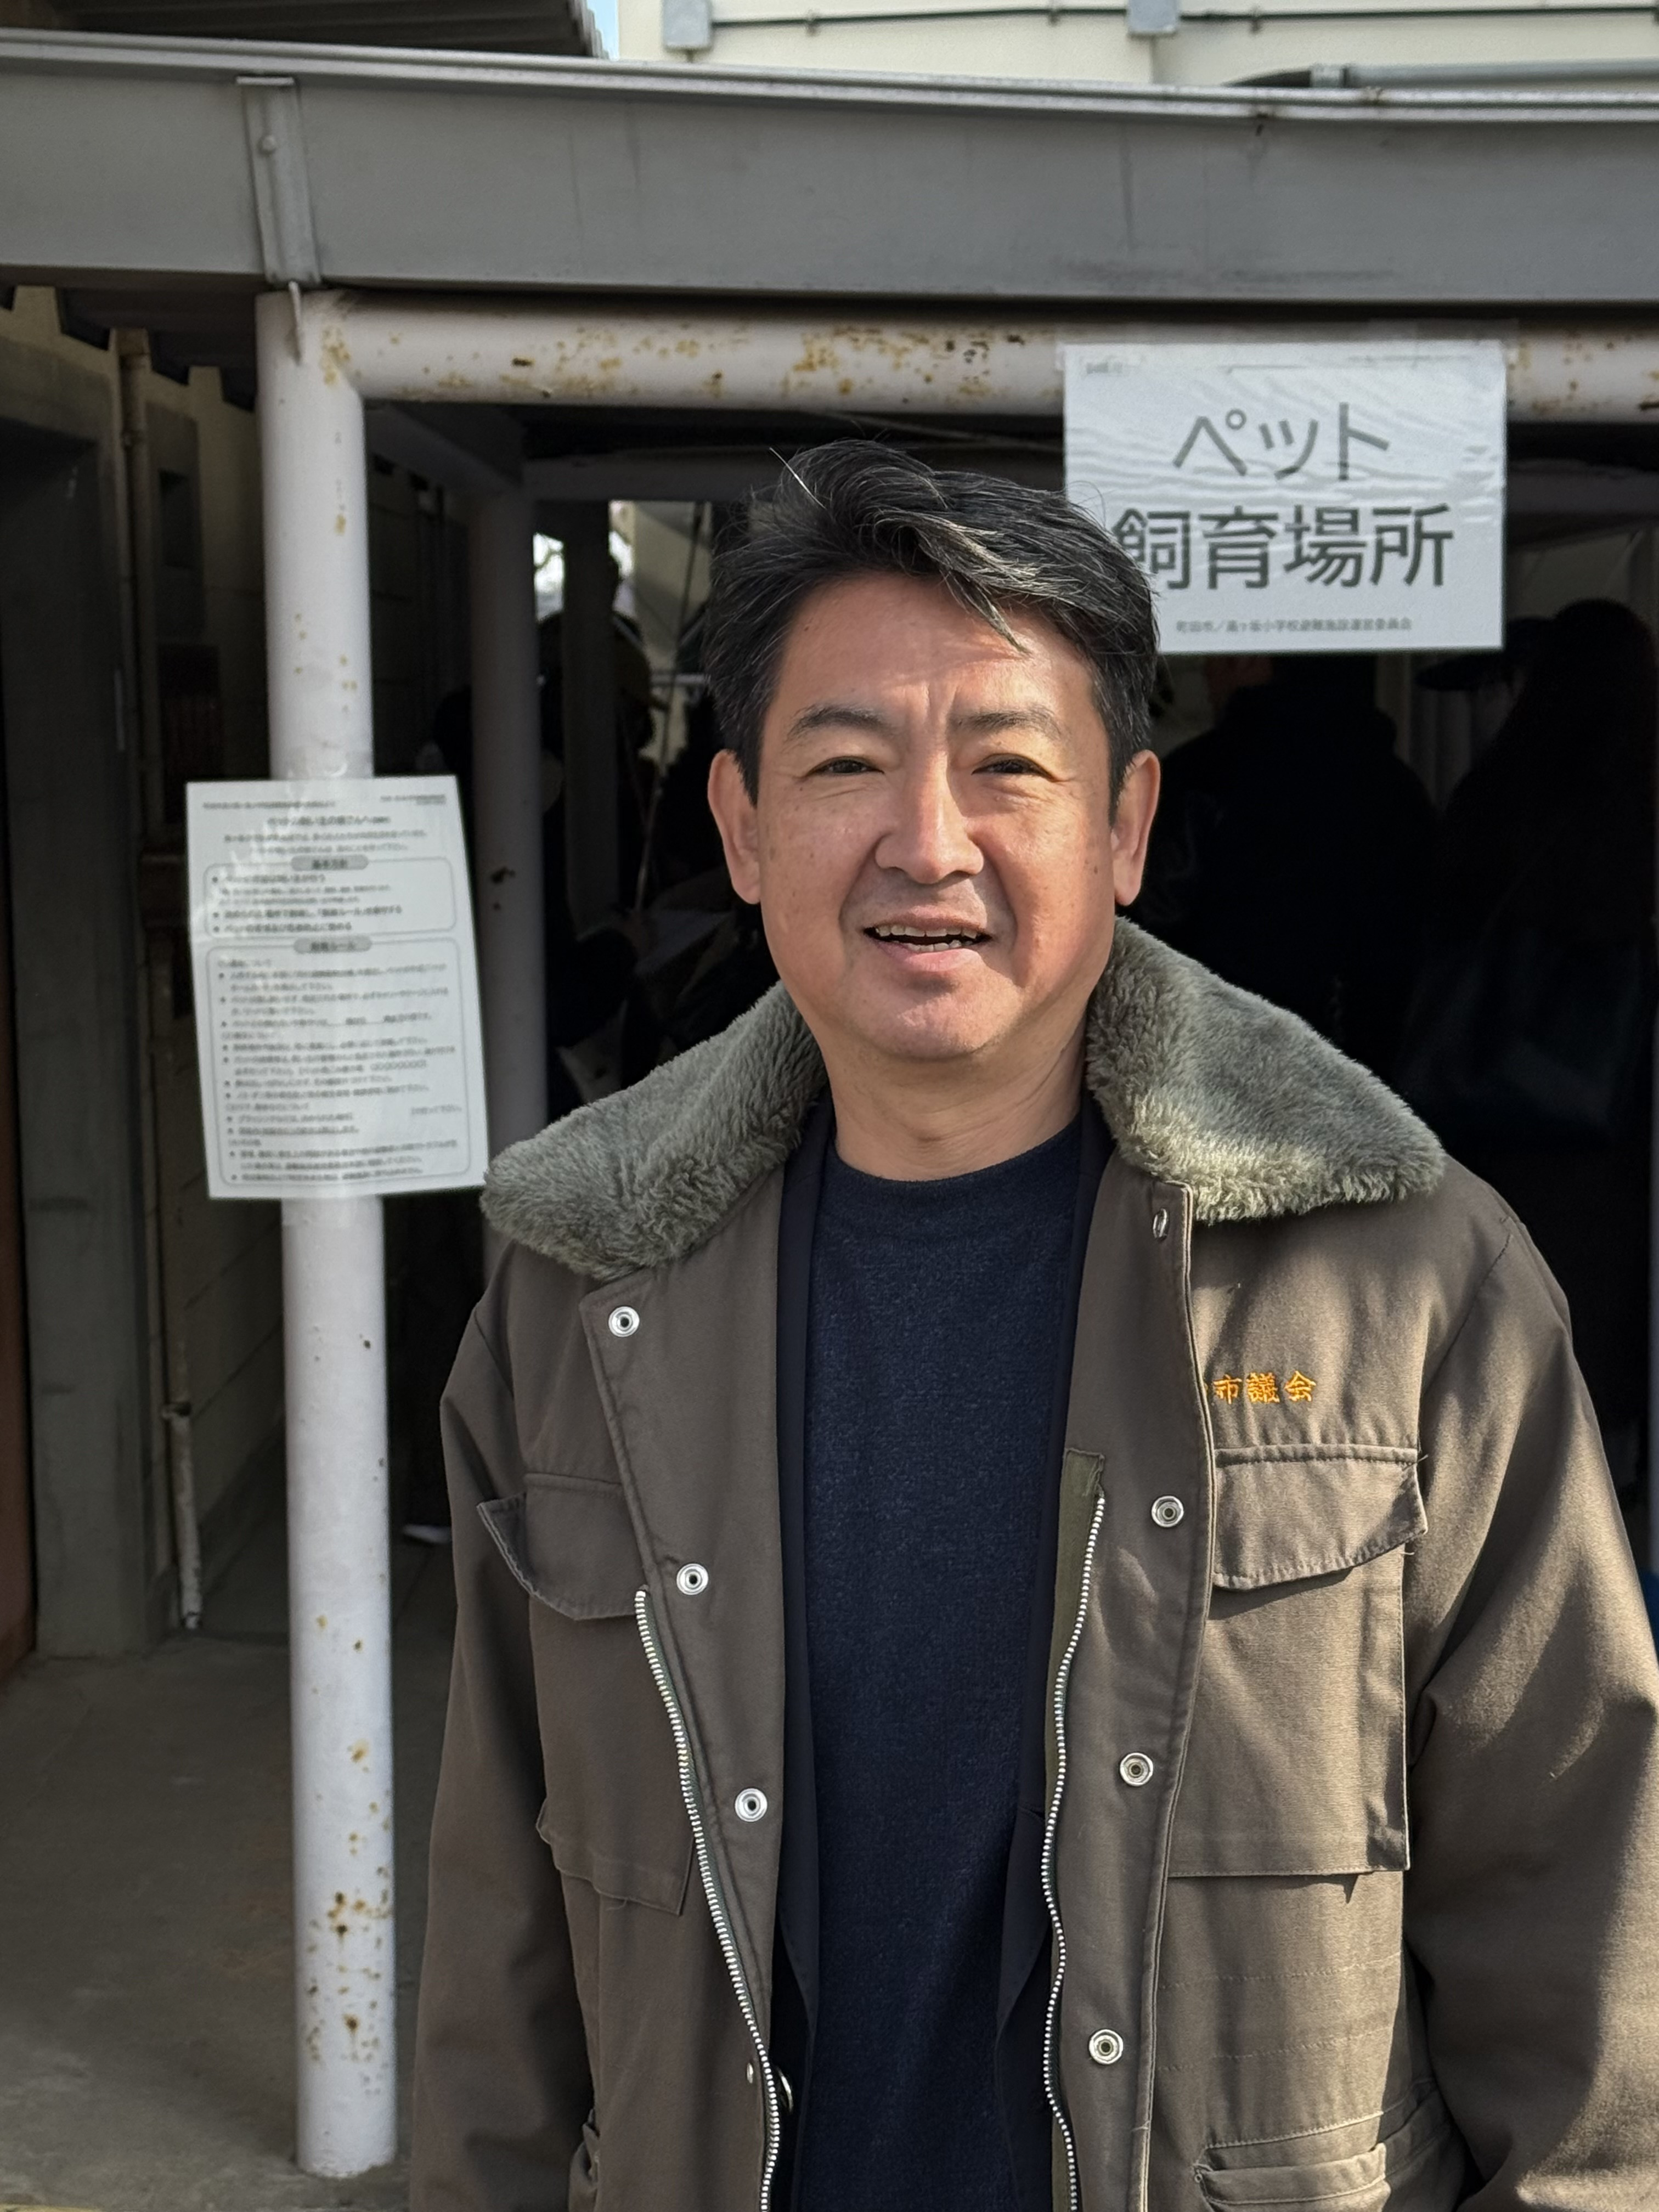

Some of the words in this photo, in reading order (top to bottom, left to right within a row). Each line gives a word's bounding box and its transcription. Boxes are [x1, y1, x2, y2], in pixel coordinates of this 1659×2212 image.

[1172, 401, 1391, 481] ペット
[1112, 504, 1455, 590] 飼育場所
[1203, 1370, 1317, 1405] 市議会
